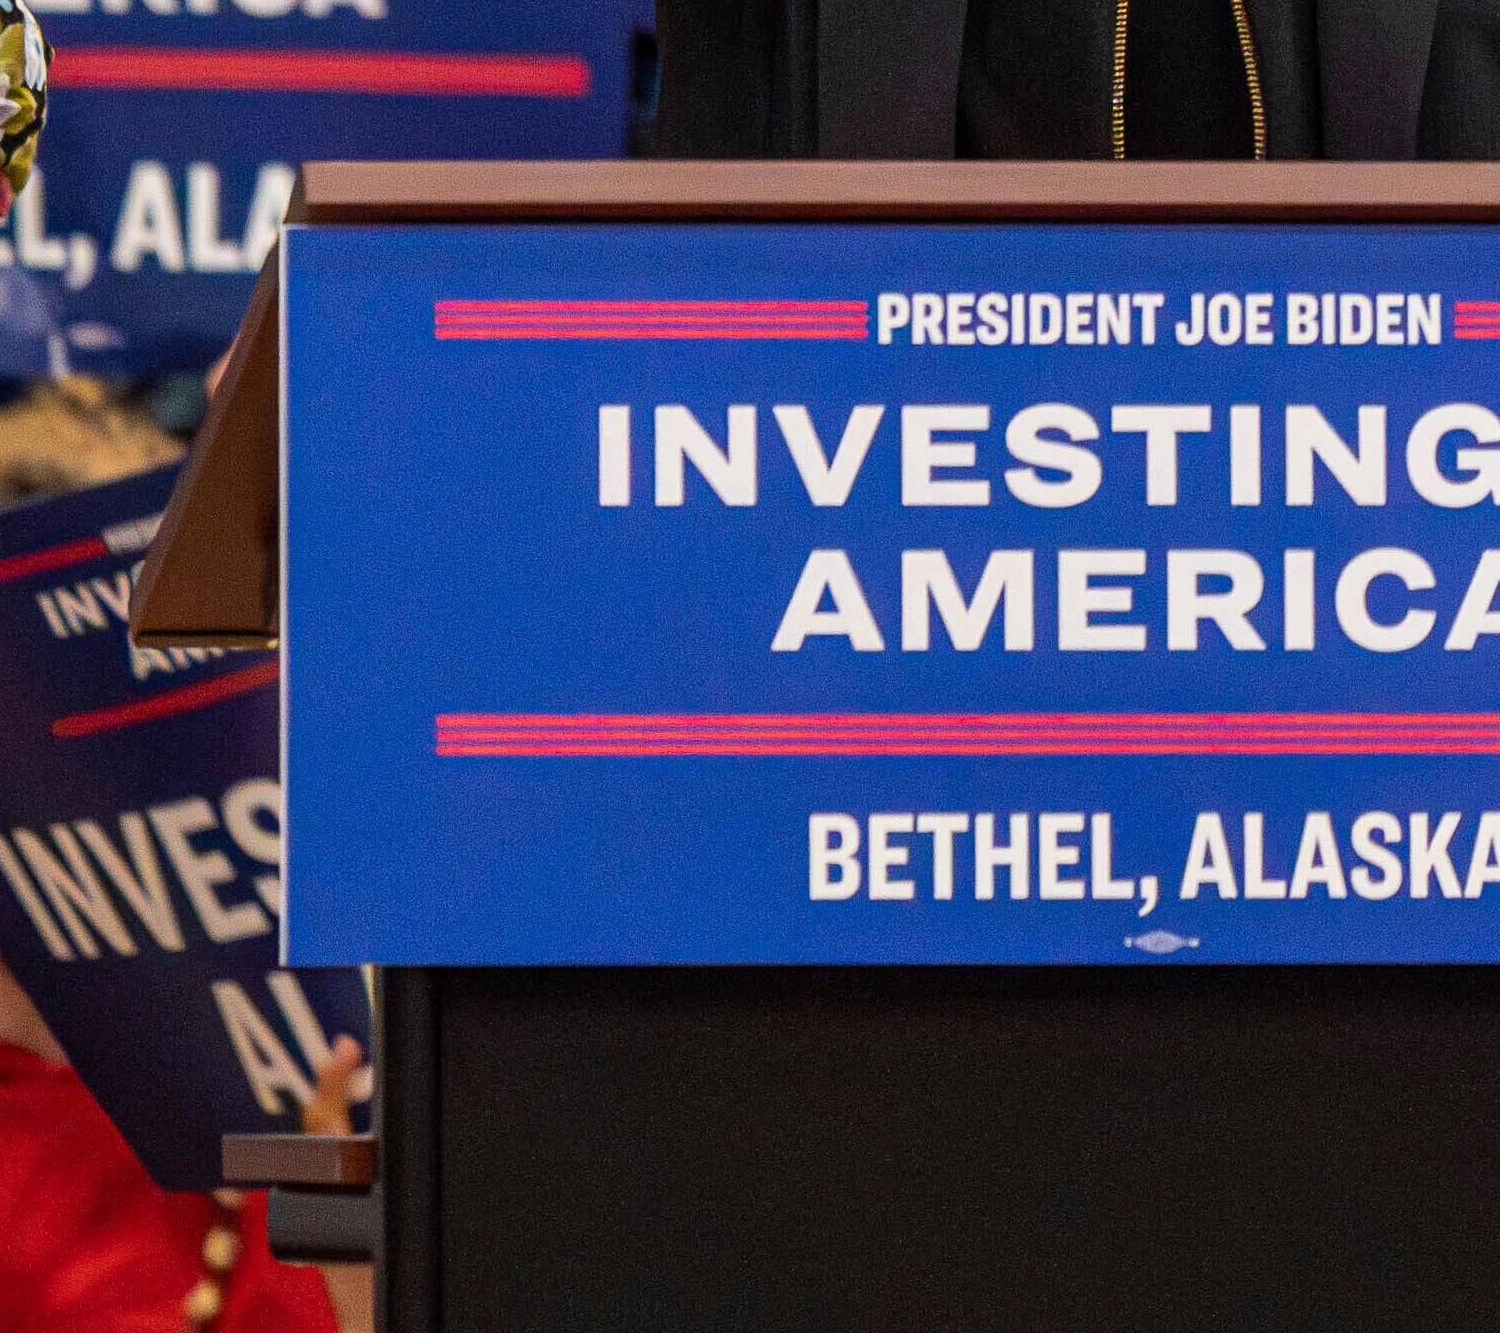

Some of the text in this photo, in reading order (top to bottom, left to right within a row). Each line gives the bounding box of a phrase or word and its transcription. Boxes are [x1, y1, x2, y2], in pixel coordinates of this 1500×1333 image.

[875, 289, 1445, 348] PRESIDENT JOE BIDEN
[806, 810, 1161, 918] BETHEL,
